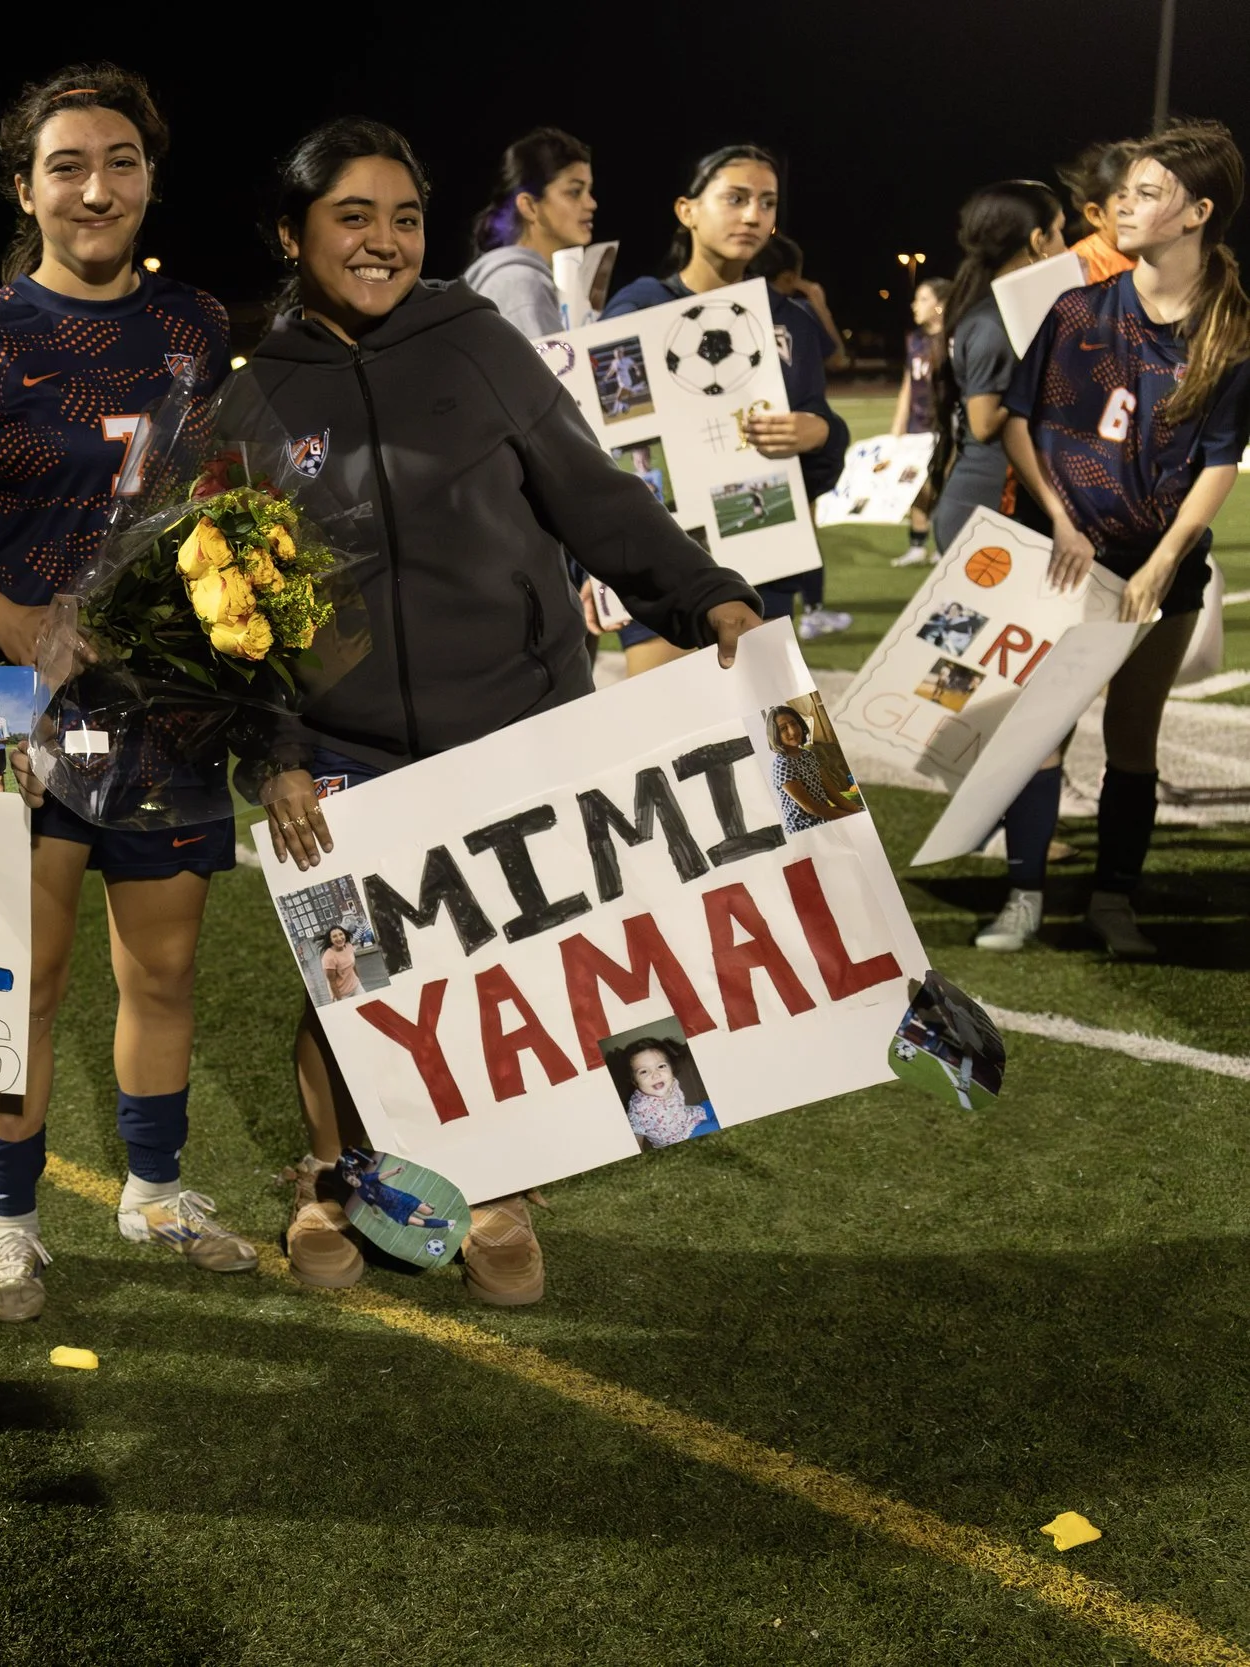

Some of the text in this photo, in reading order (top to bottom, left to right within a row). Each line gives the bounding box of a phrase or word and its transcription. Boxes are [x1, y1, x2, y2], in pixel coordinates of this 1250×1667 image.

[101, 413, 150, 497] 7
[1097, 386, 1137, 443] 6
[362, 735, 787, 977] MIMI
[356, 856, 903, 1125] YAMAL
